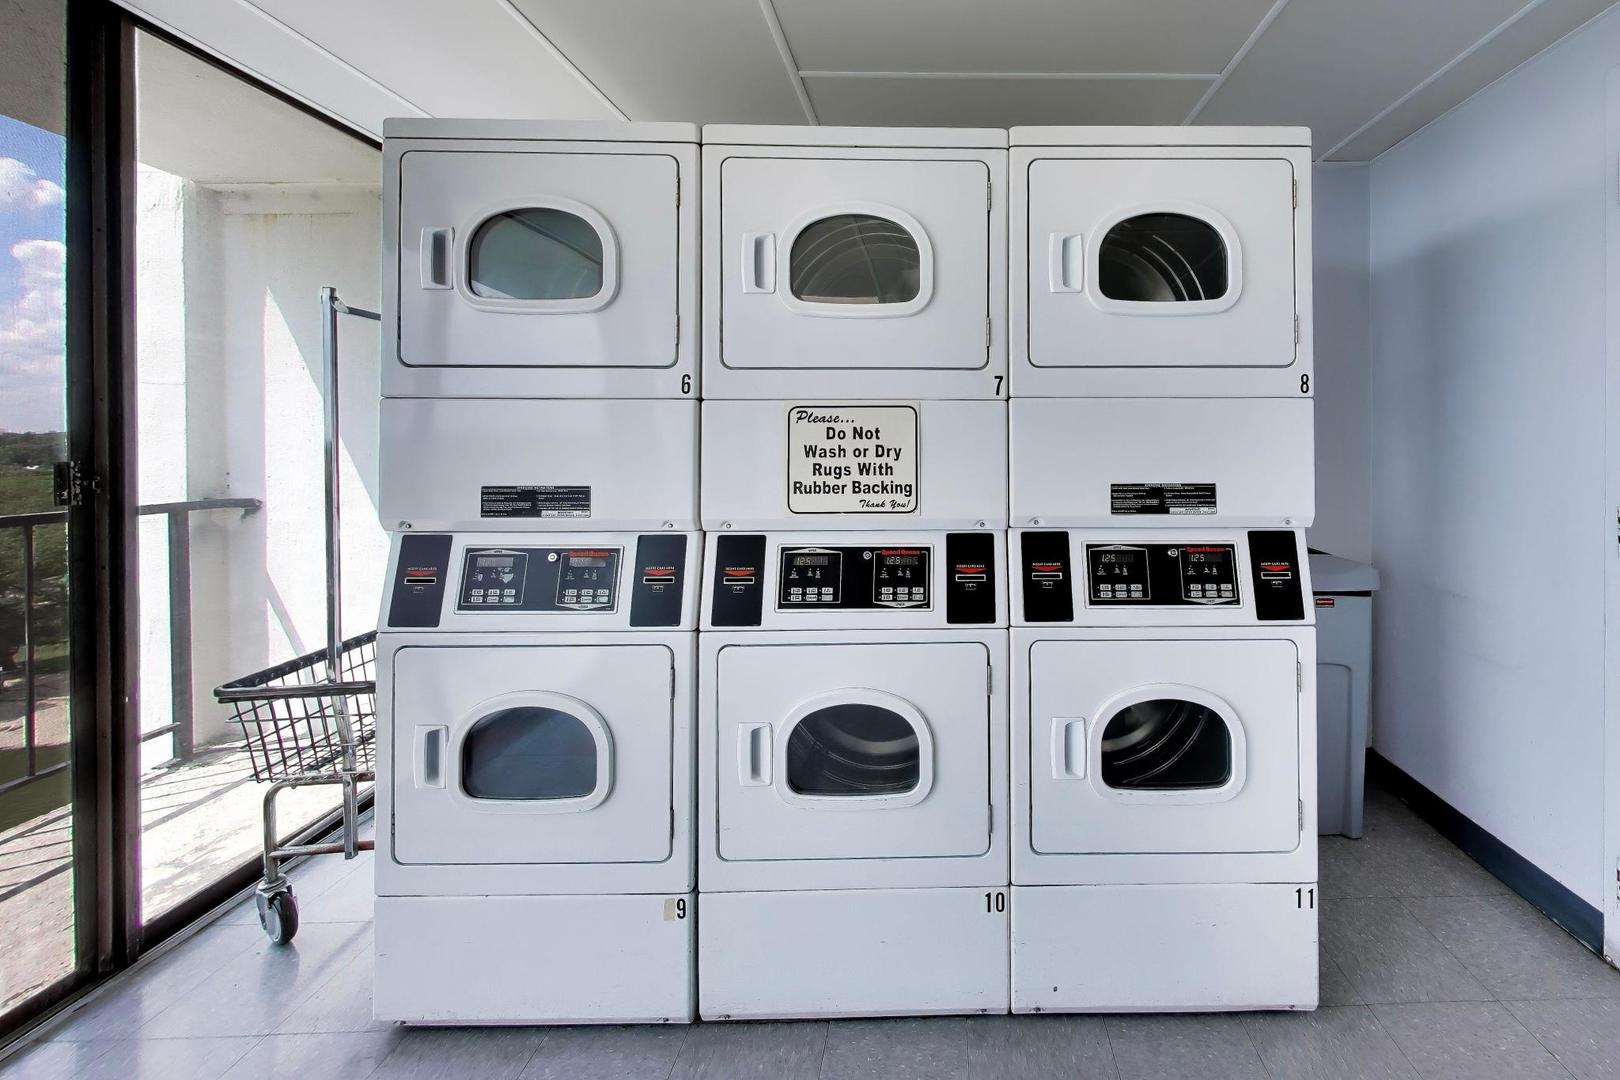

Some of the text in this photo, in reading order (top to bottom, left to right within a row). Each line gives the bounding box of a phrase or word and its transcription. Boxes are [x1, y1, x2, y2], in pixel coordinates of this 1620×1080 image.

[681, 374, 691, 394] 6
[994, 375, 1004, 396] 7
[1300, 373, 1310, 394] 8
[796, 410, 855, 423] Please...
[826, 426, 881, 440] Do Not
[803, 444, 902, 461] Wash or Dry
[812, 462, 894, 480] Rugs With
[793, 480, 913, 497] Rubber Backing
[859, 499, 911, 510] Thank You!
[985, 892, 1005, 913] 10
[1295, 888, 1314, 909] 11
[676, 898, 686, 919] 9
